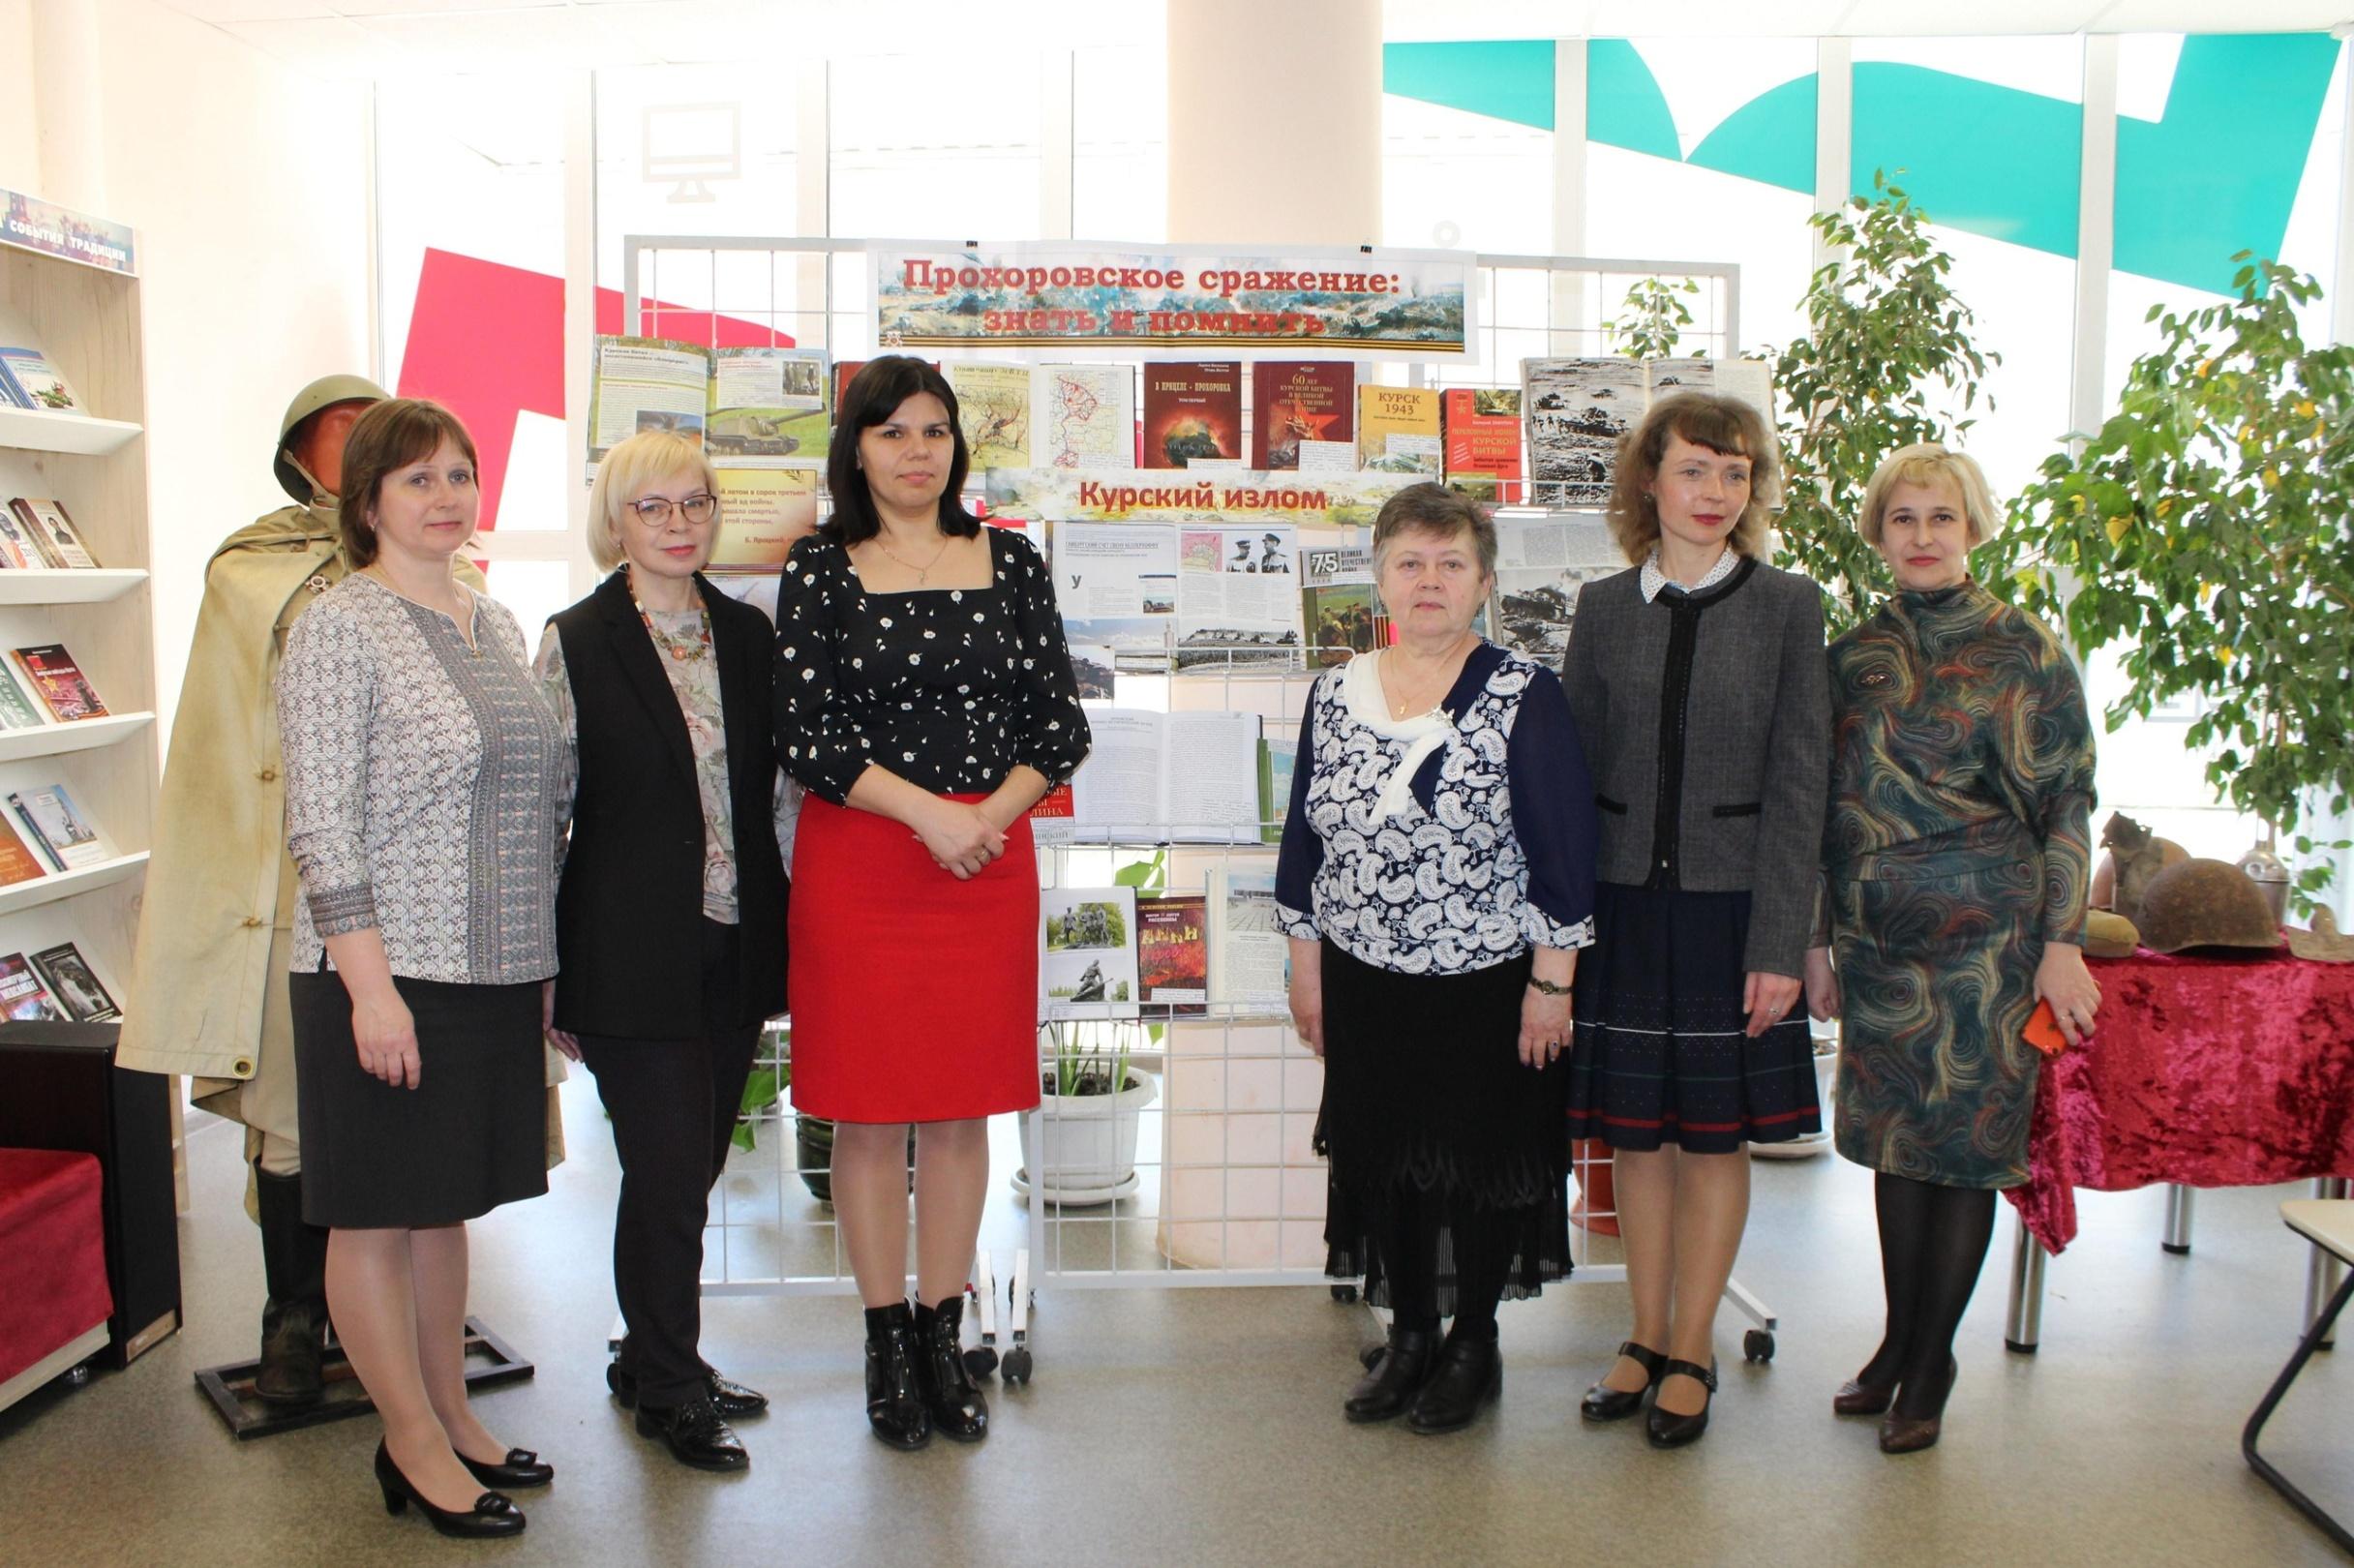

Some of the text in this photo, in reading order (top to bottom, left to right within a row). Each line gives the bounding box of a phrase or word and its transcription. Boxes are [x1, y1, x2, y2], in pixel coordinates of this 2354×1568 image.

[10, 221, 65, 246] СОБЫТИЯ
[69, 236, 127, 262] ТРАДИЦИИ
[902, 258, 1402, 295] Прохоровское сражение:
[983, 309, 1326, 334] знать и помнить
[1194, 382, 1231, 392] ПРОХОРОВКА
[1292, 374, 1306, 385] 60
[1378, 392, 1421, 404] КУРСК
[1385, 403, 1414, 415] 1943
[1079, 481, 1328, 513] Курский излом
[1312, 553, 1338, 573] 75
[1029, 806, 1064, 818] ЛИНА
